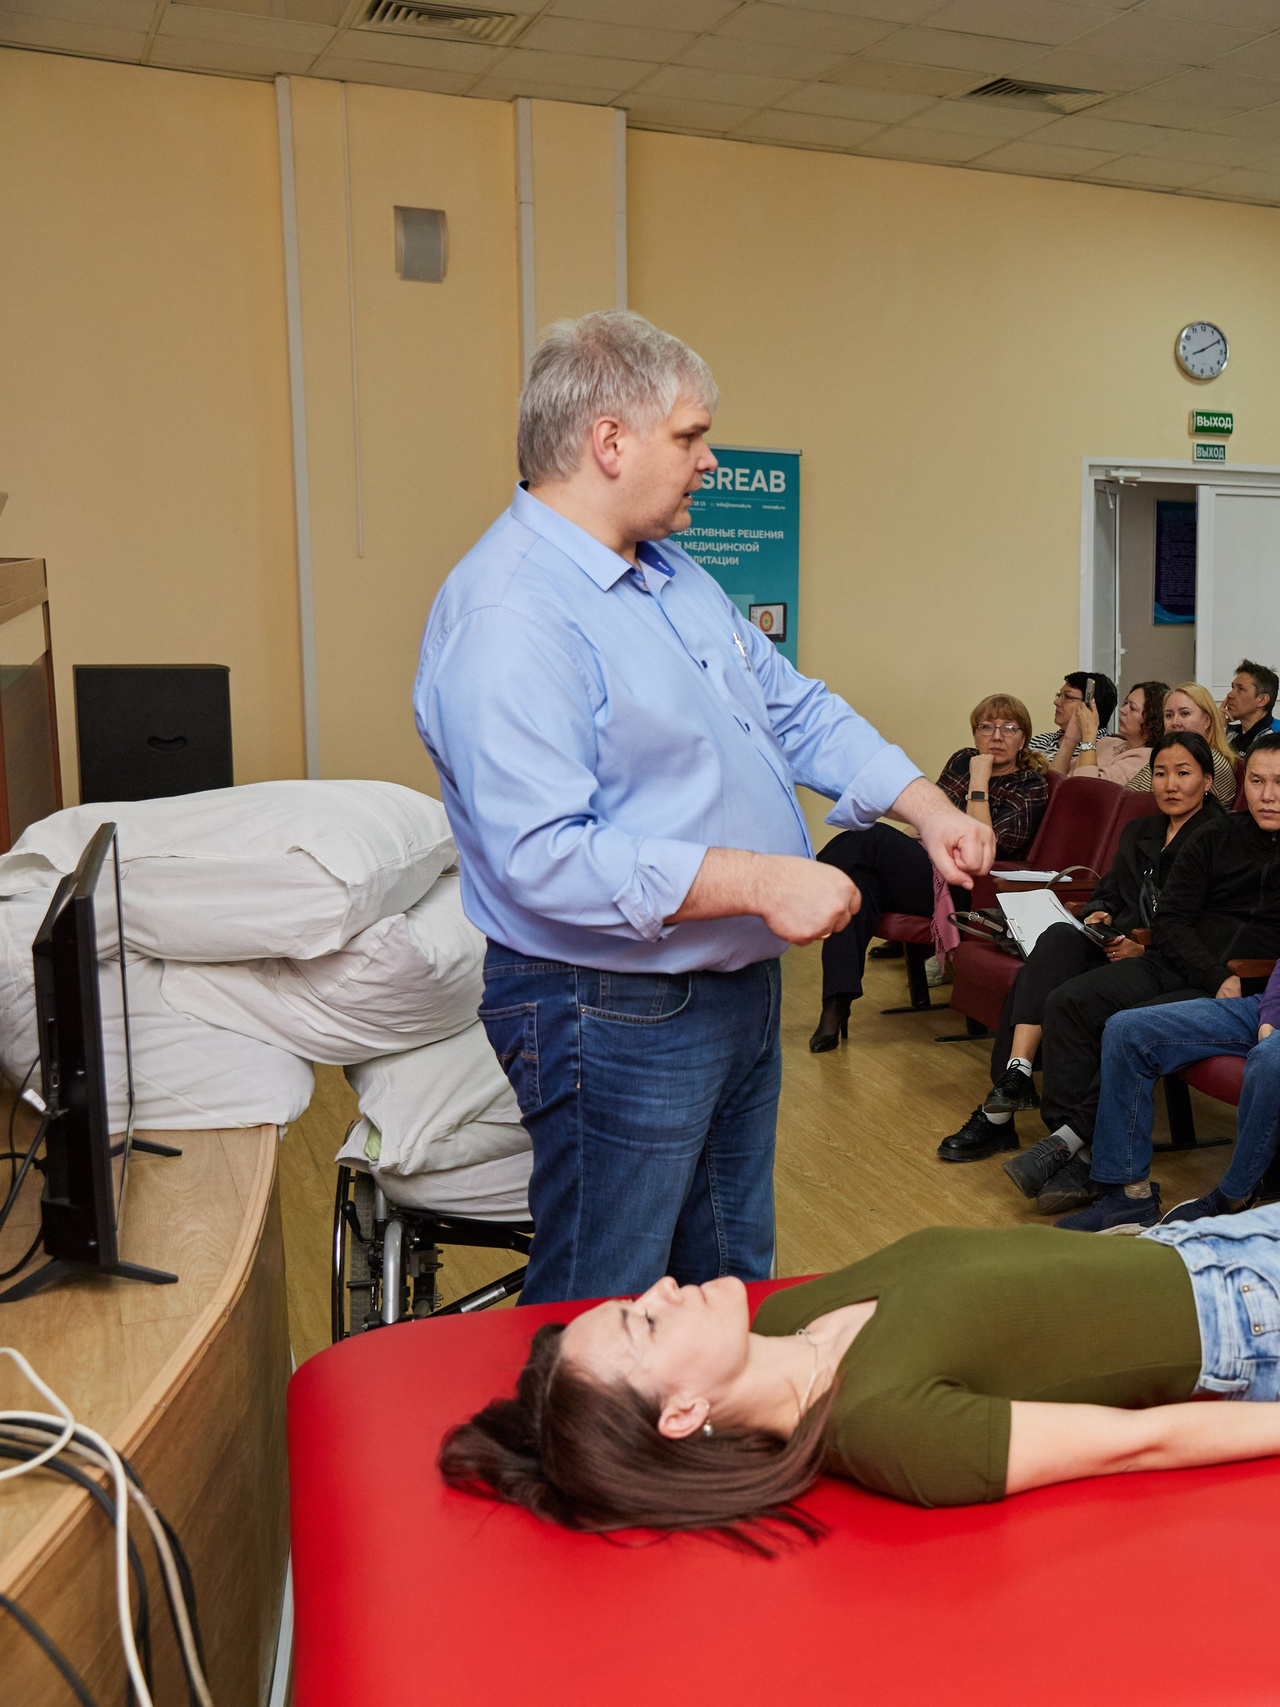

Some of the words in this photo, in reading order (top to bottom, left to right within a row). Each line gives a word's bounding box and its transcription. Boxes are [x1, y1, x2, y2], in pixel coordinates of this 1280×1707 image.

[1196, 415, 1232, 430] ВЫХОД
[1196, 446, 1225, 460] ВЫХОД
[702, 467, 786, 493] SREAB
[738, 529, 784, 539] РЕШЕНИЯ
[684, 541, 760, 553] МЕДИЦИНСКОЙ
[692, 555, 739, 567] ЛИТАЦИИ
